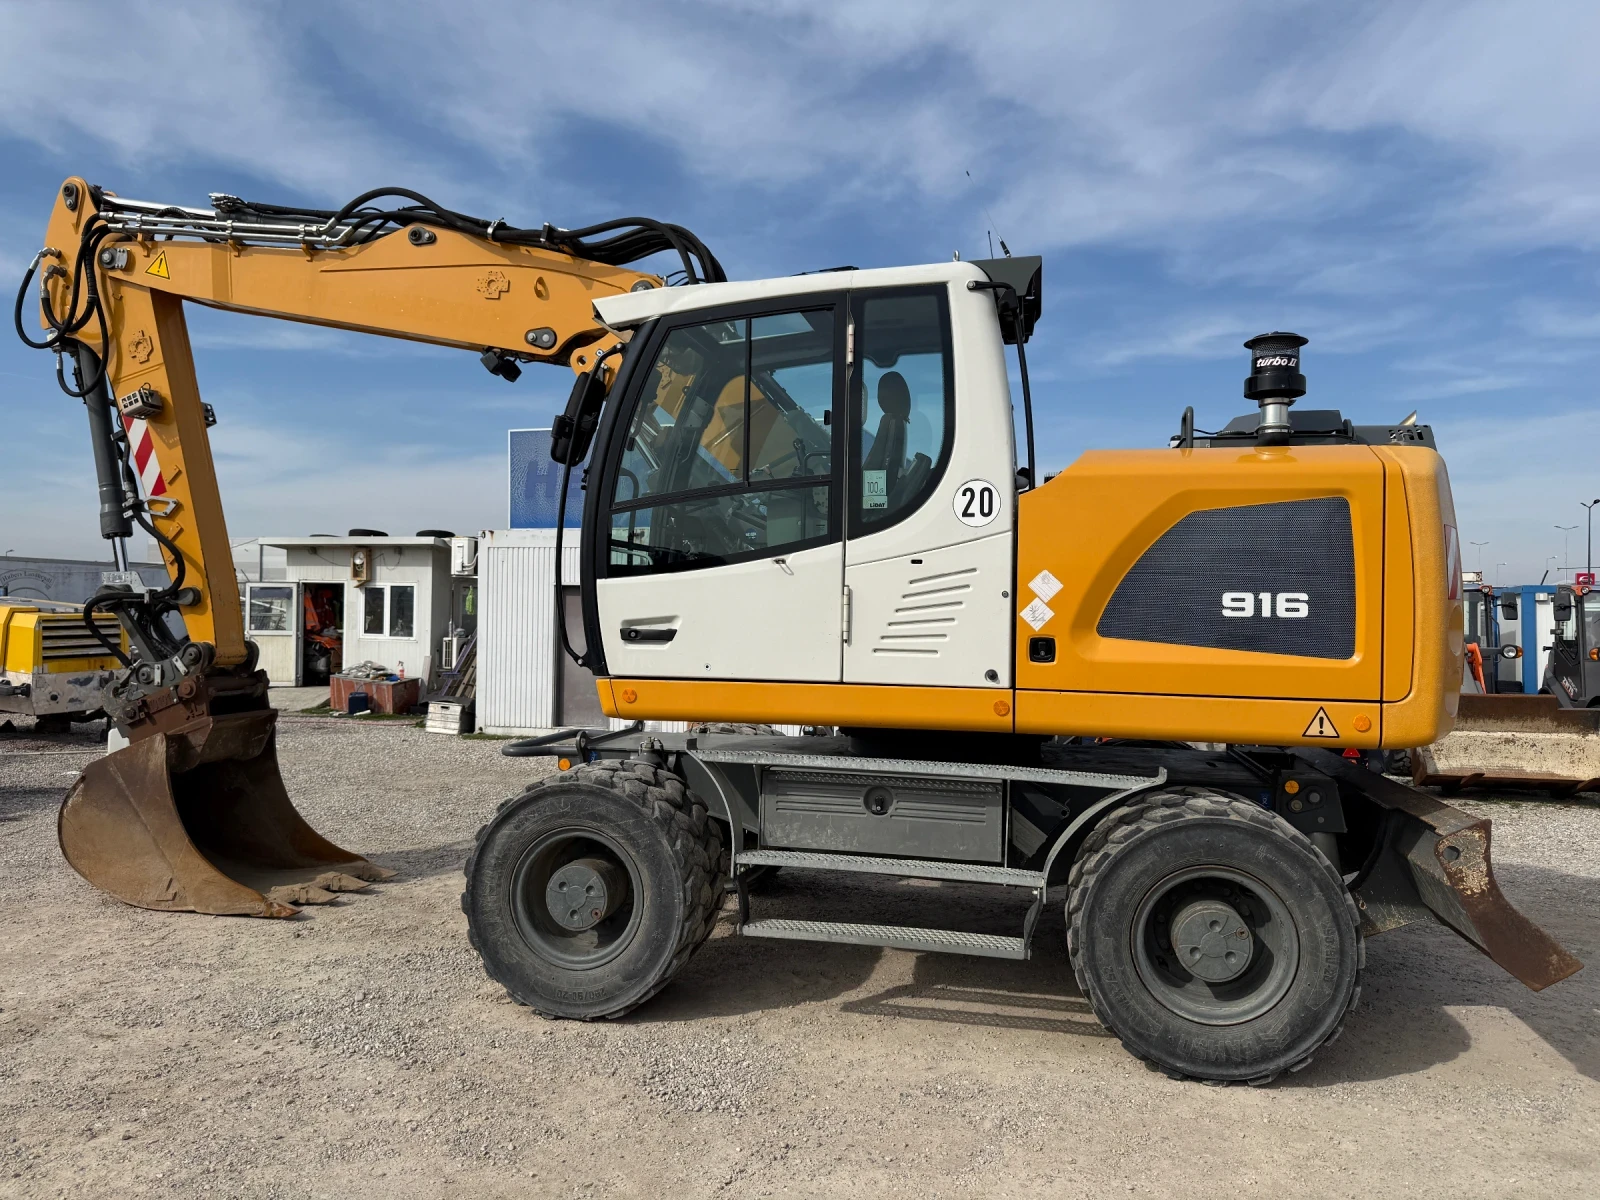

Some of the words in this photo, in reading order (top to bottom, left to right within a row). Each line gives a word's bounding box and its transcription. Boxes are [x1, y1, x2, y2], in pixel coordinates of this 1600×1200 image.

[1256, 356, 1288, 367] turbo
[961, 486, 993, 518] 20
[1222, 592, 1309, 617] 916
